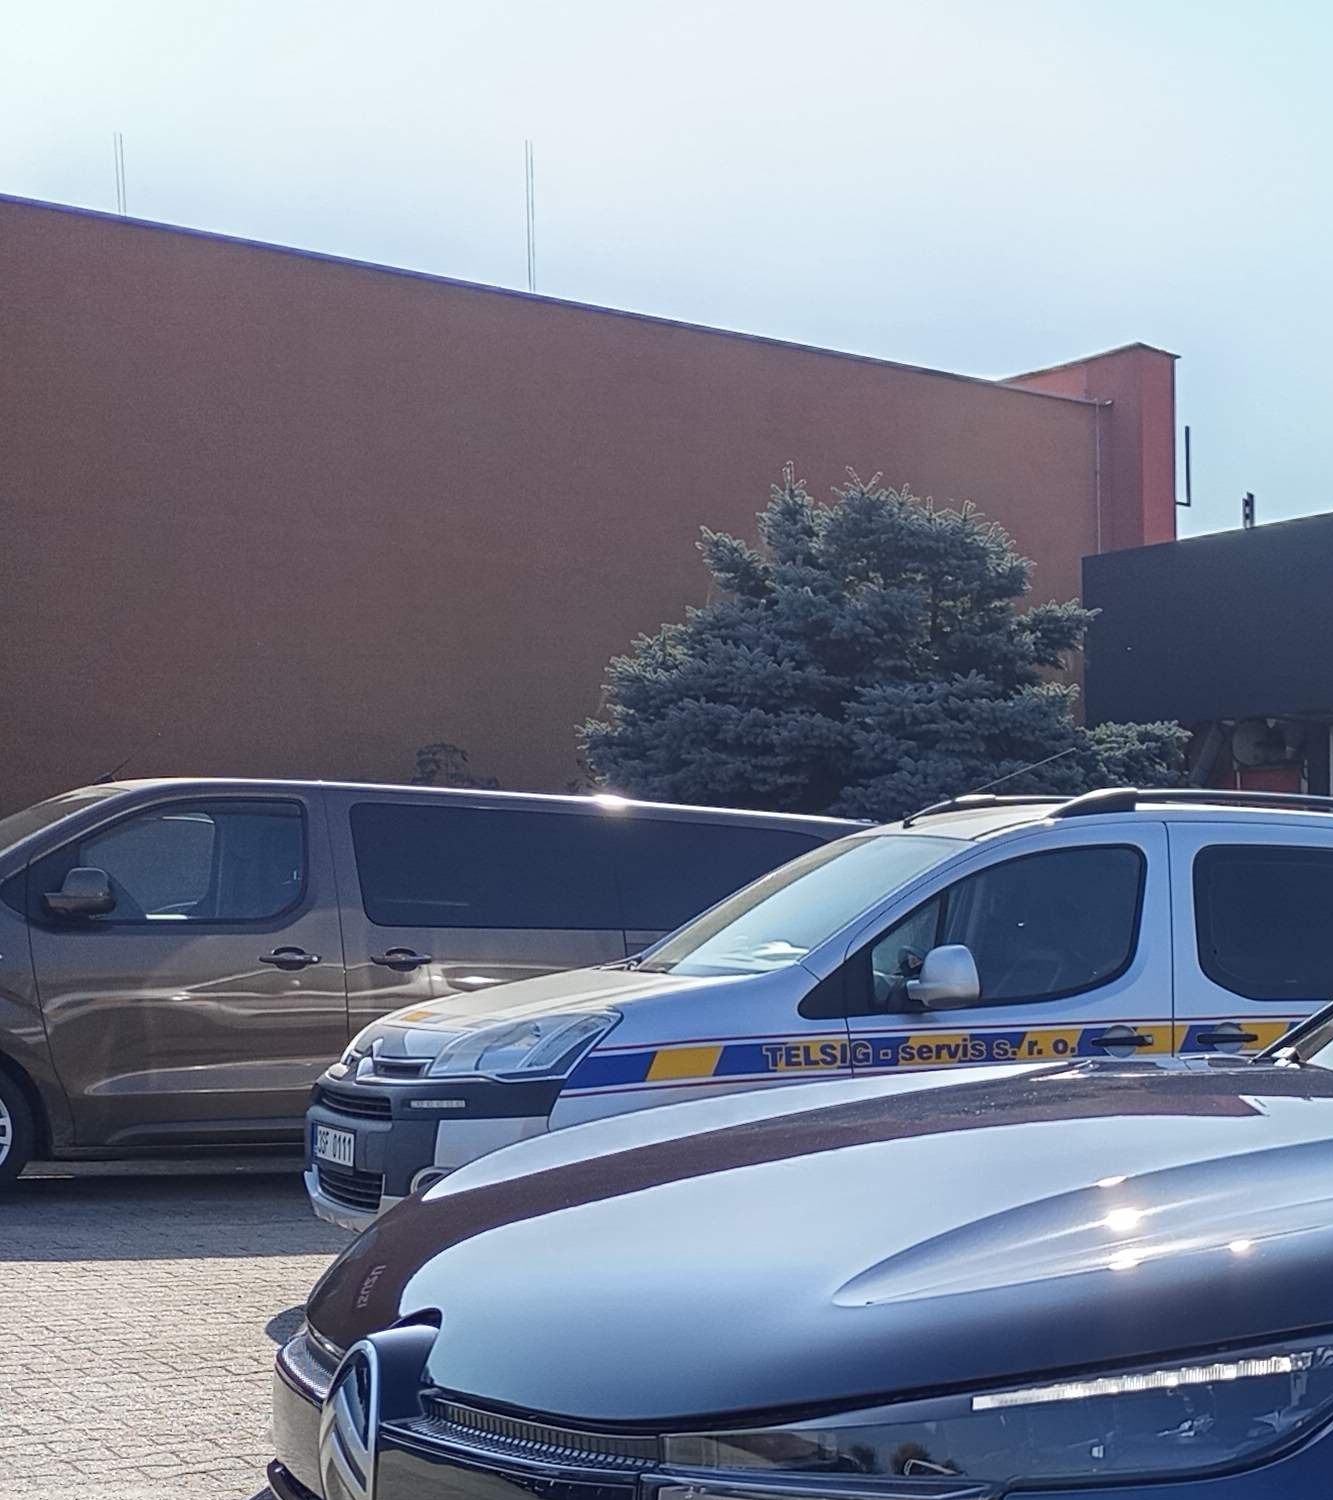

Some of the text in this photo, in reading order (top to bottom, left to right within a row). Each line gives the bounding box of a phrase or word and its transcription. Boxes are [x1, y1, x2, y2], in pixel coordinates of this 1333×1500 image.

[763, 1040, 872, 1069] TELSIG
[899, 1037, 986, 1062] servis
[992, 1039, 1017, 1060] s.
[1027, 1039, 1043, 1056] r.
[1052, 1037, 1077, 1056] o.
[333, 1134, 352, 1162] 0111
